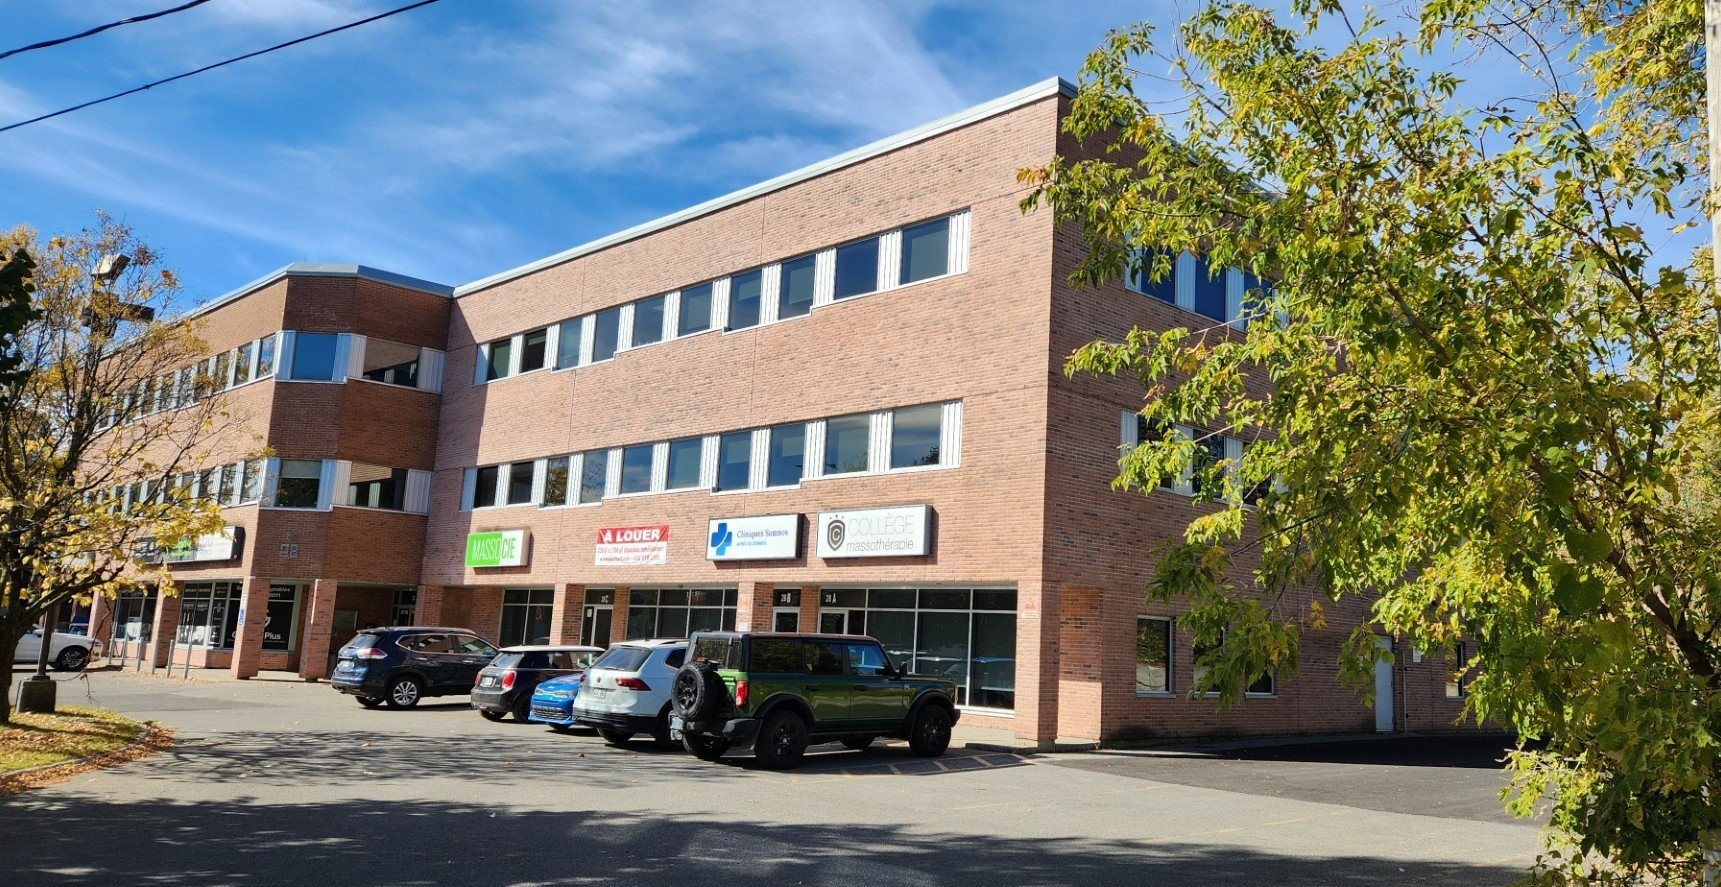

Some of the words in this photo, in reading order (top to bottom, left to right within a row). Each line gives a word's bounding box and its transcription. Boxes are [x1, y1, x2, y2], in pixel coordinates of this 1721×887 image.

[848, 512, 914, 536] COLLÈGE
[615, 528, 661, 542] LOUER
[736, 529, 764, 540] Cliniques
[765, 529, 789, 537] Somnos
[845, 538, 914, 552] massothérapie
[264, 632, 282, 640] Plus
